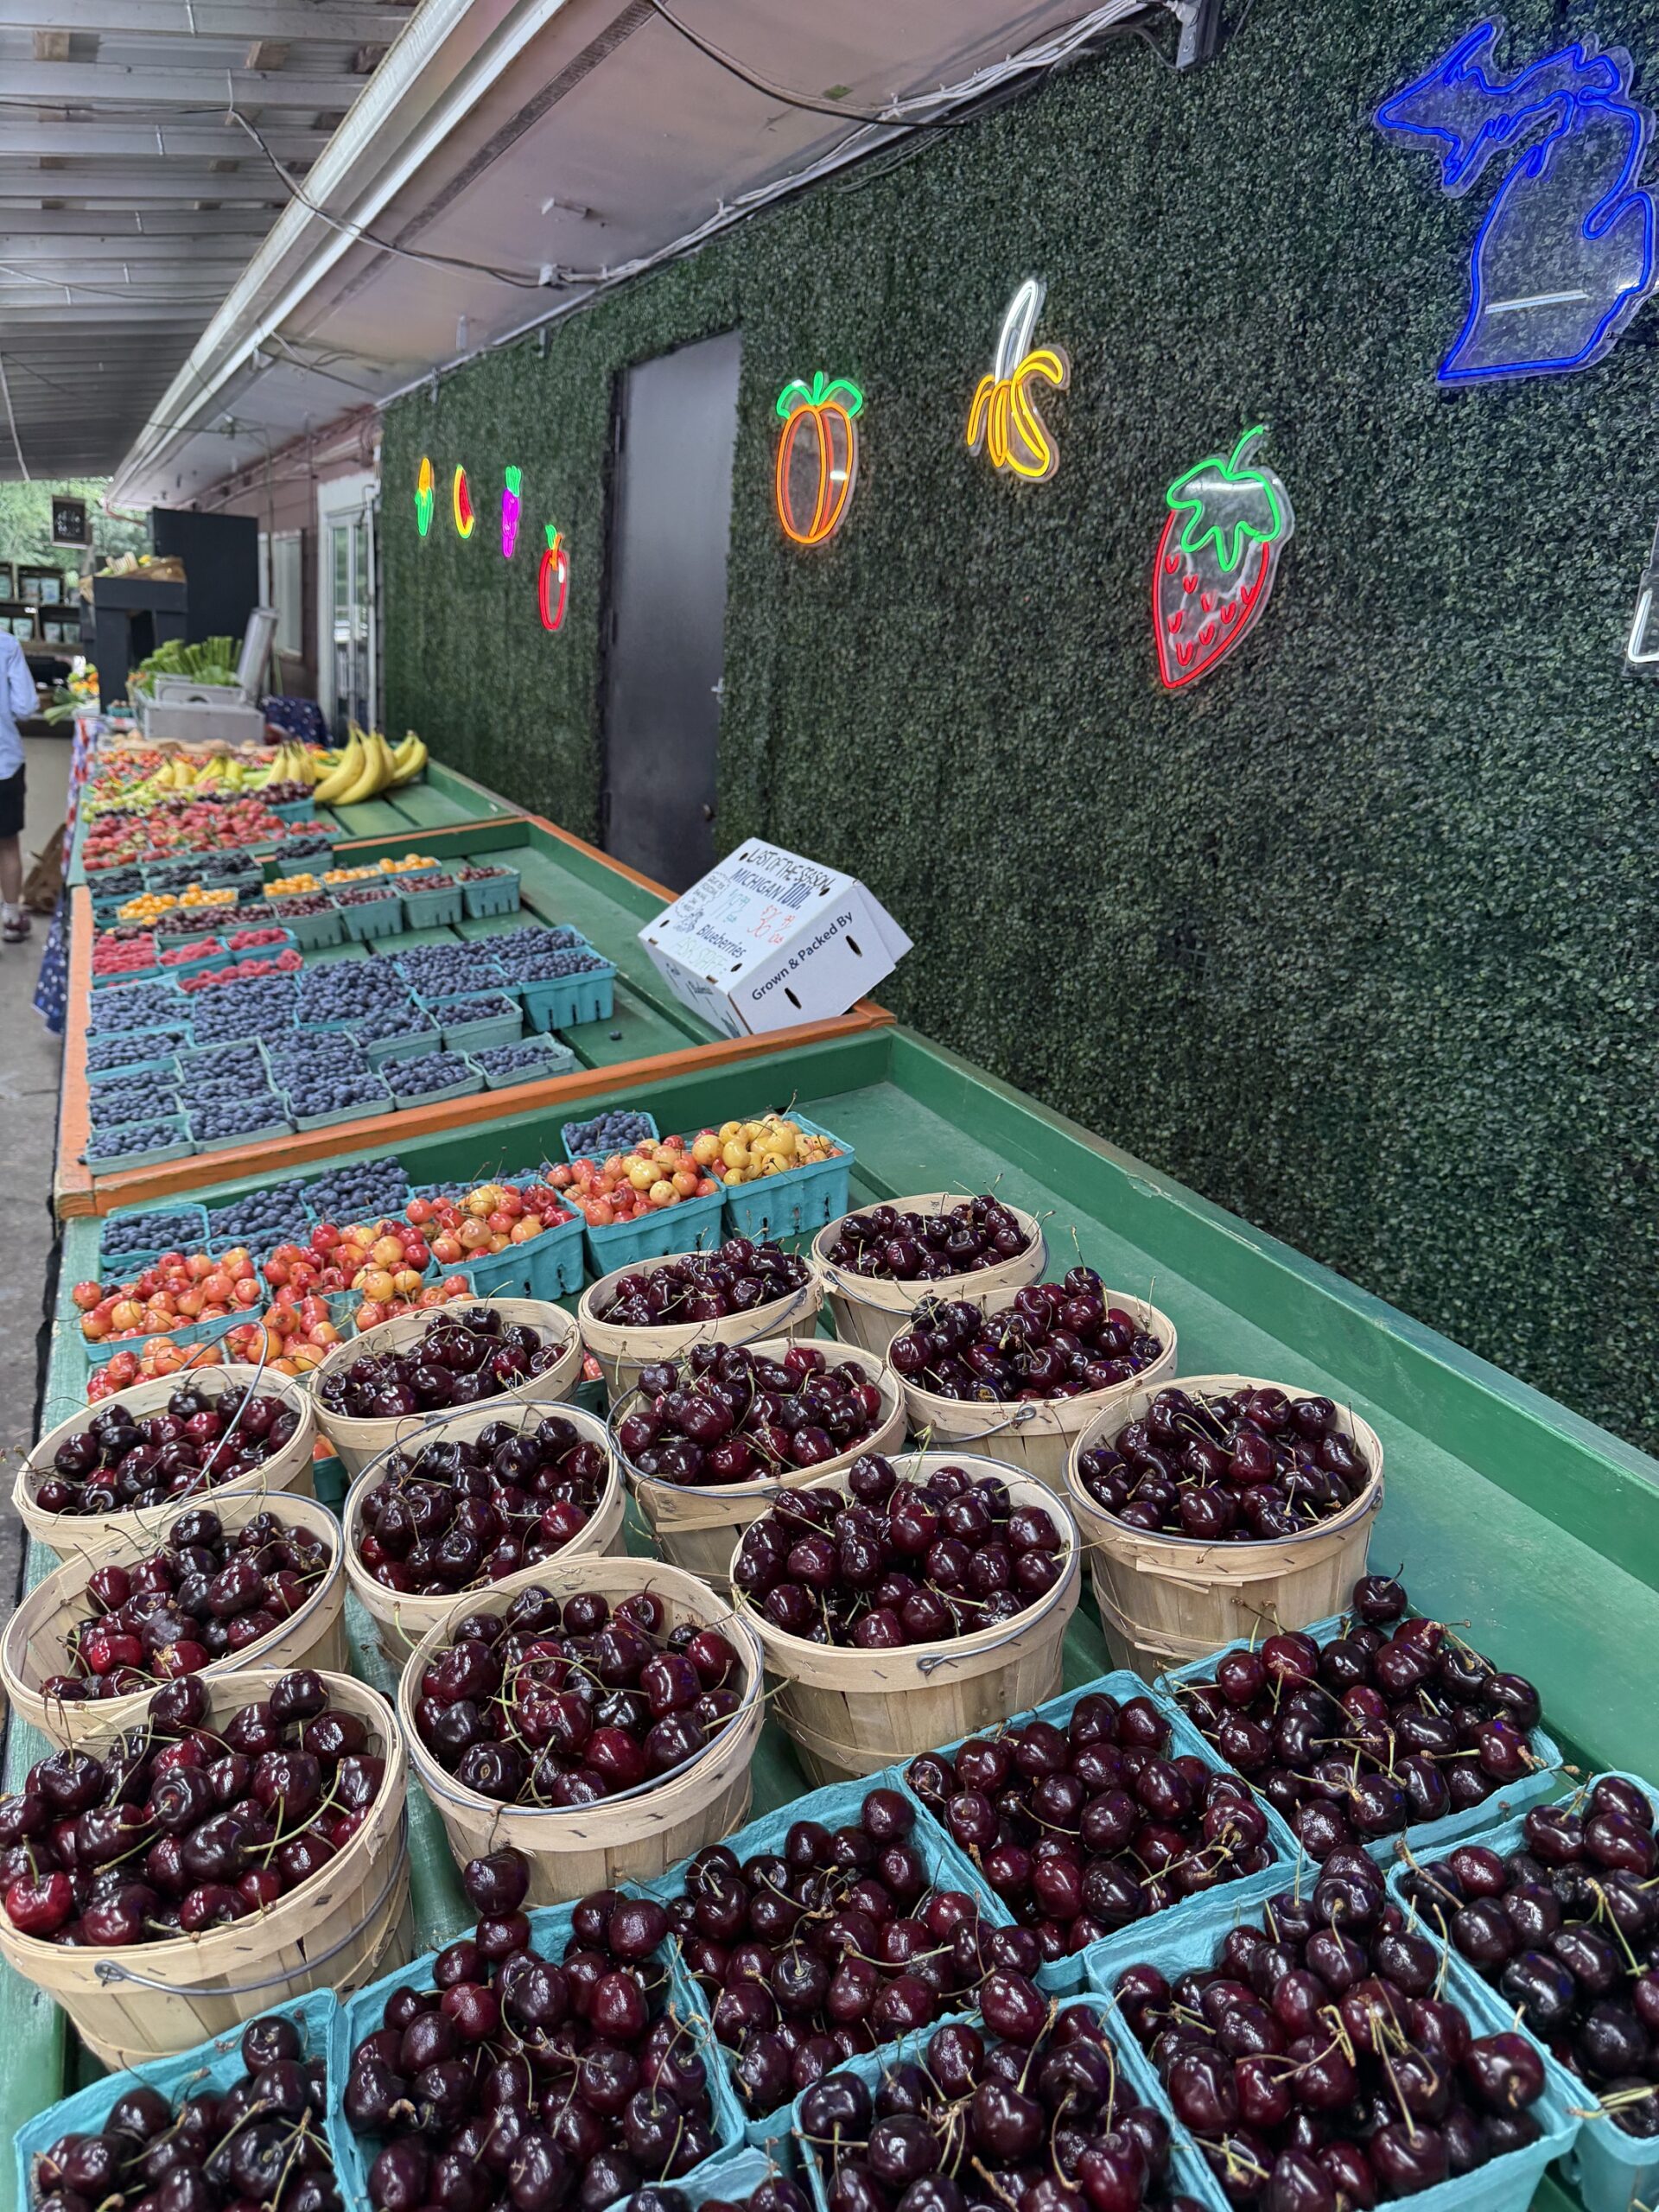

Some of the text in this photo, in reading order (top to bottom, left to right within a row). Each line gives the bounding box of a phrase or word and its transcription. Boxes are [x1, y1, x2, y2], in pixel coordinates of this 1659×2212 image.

[730, 868, 785, 899] MICHIGAN
[746, 848, 836, 891] LAST OF THE SEASON
[696, 924, 747, 957] Blueberries
[752, 912, 853, 1000] Grown & Packed By
